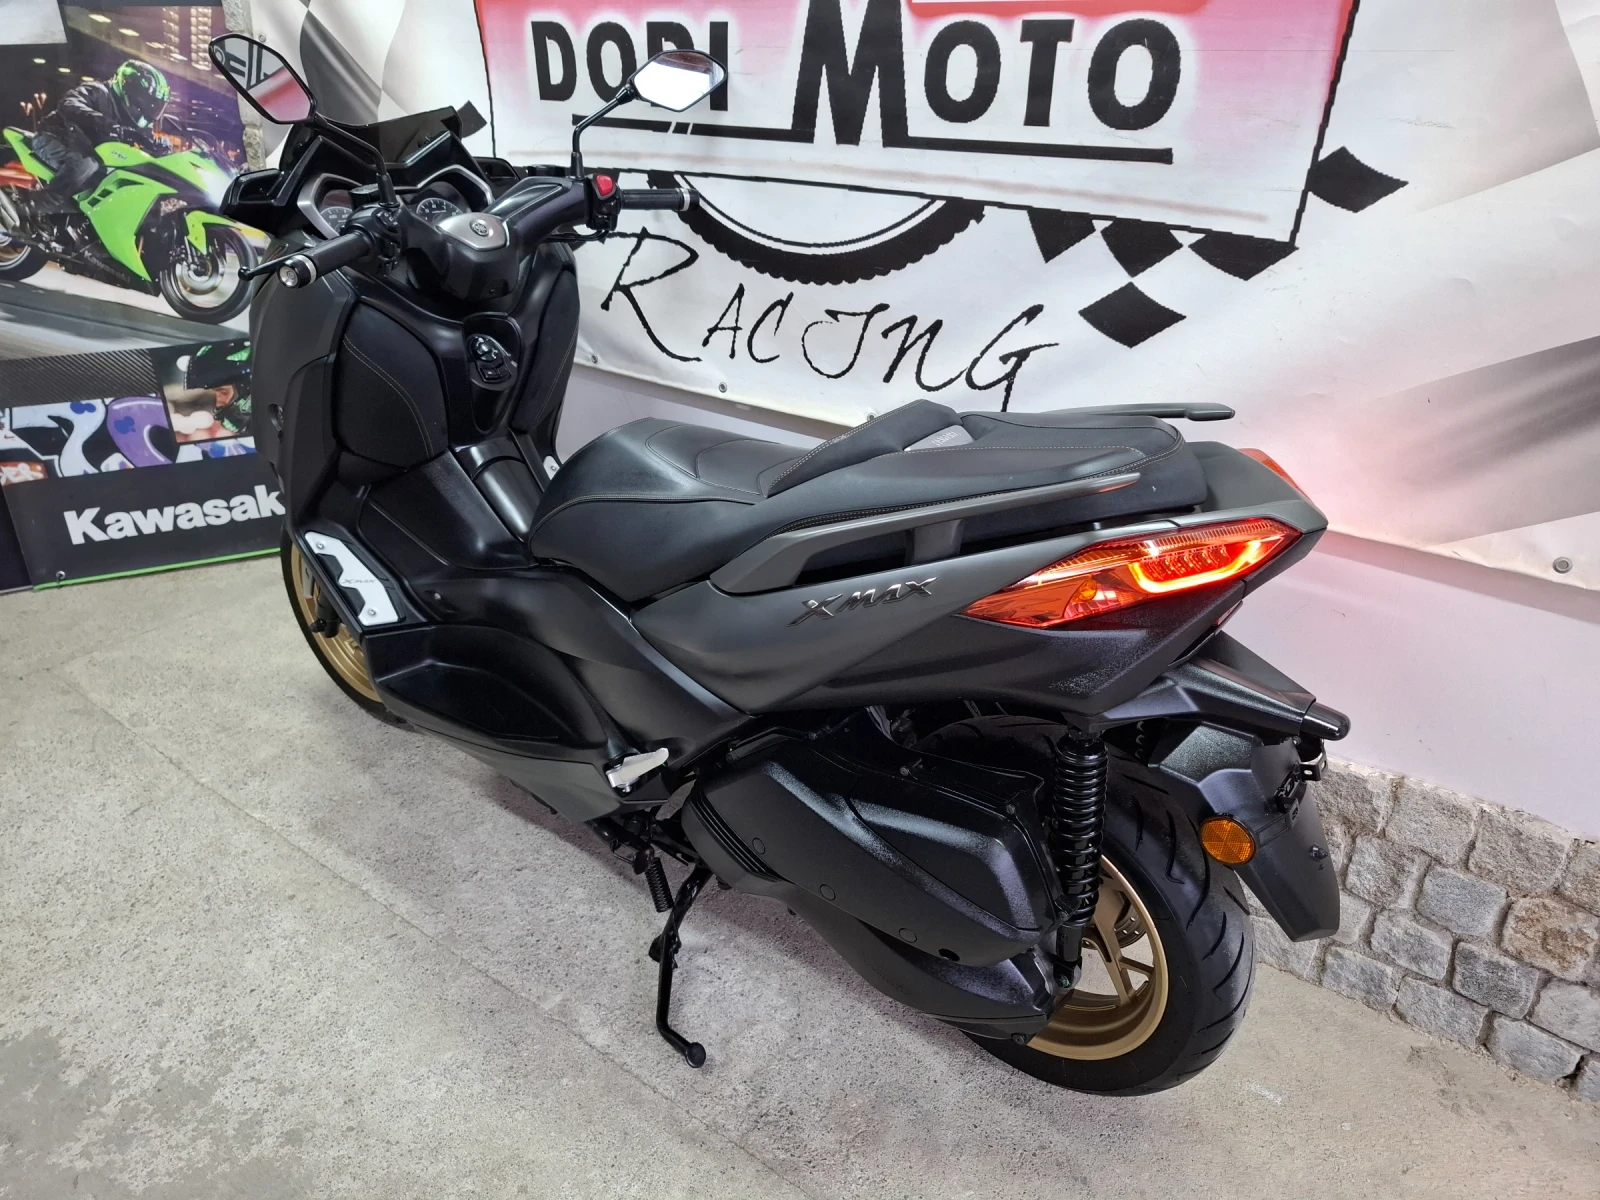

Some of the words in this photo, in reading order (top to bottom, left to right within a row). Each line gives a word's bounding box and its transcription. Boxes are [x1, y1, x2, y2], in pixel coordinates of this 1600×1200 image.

[791, 0, 1182, 148] MOTO
[594, 226, 1059, 412] RACING
[63, 484, 286, 545] Kawasak
